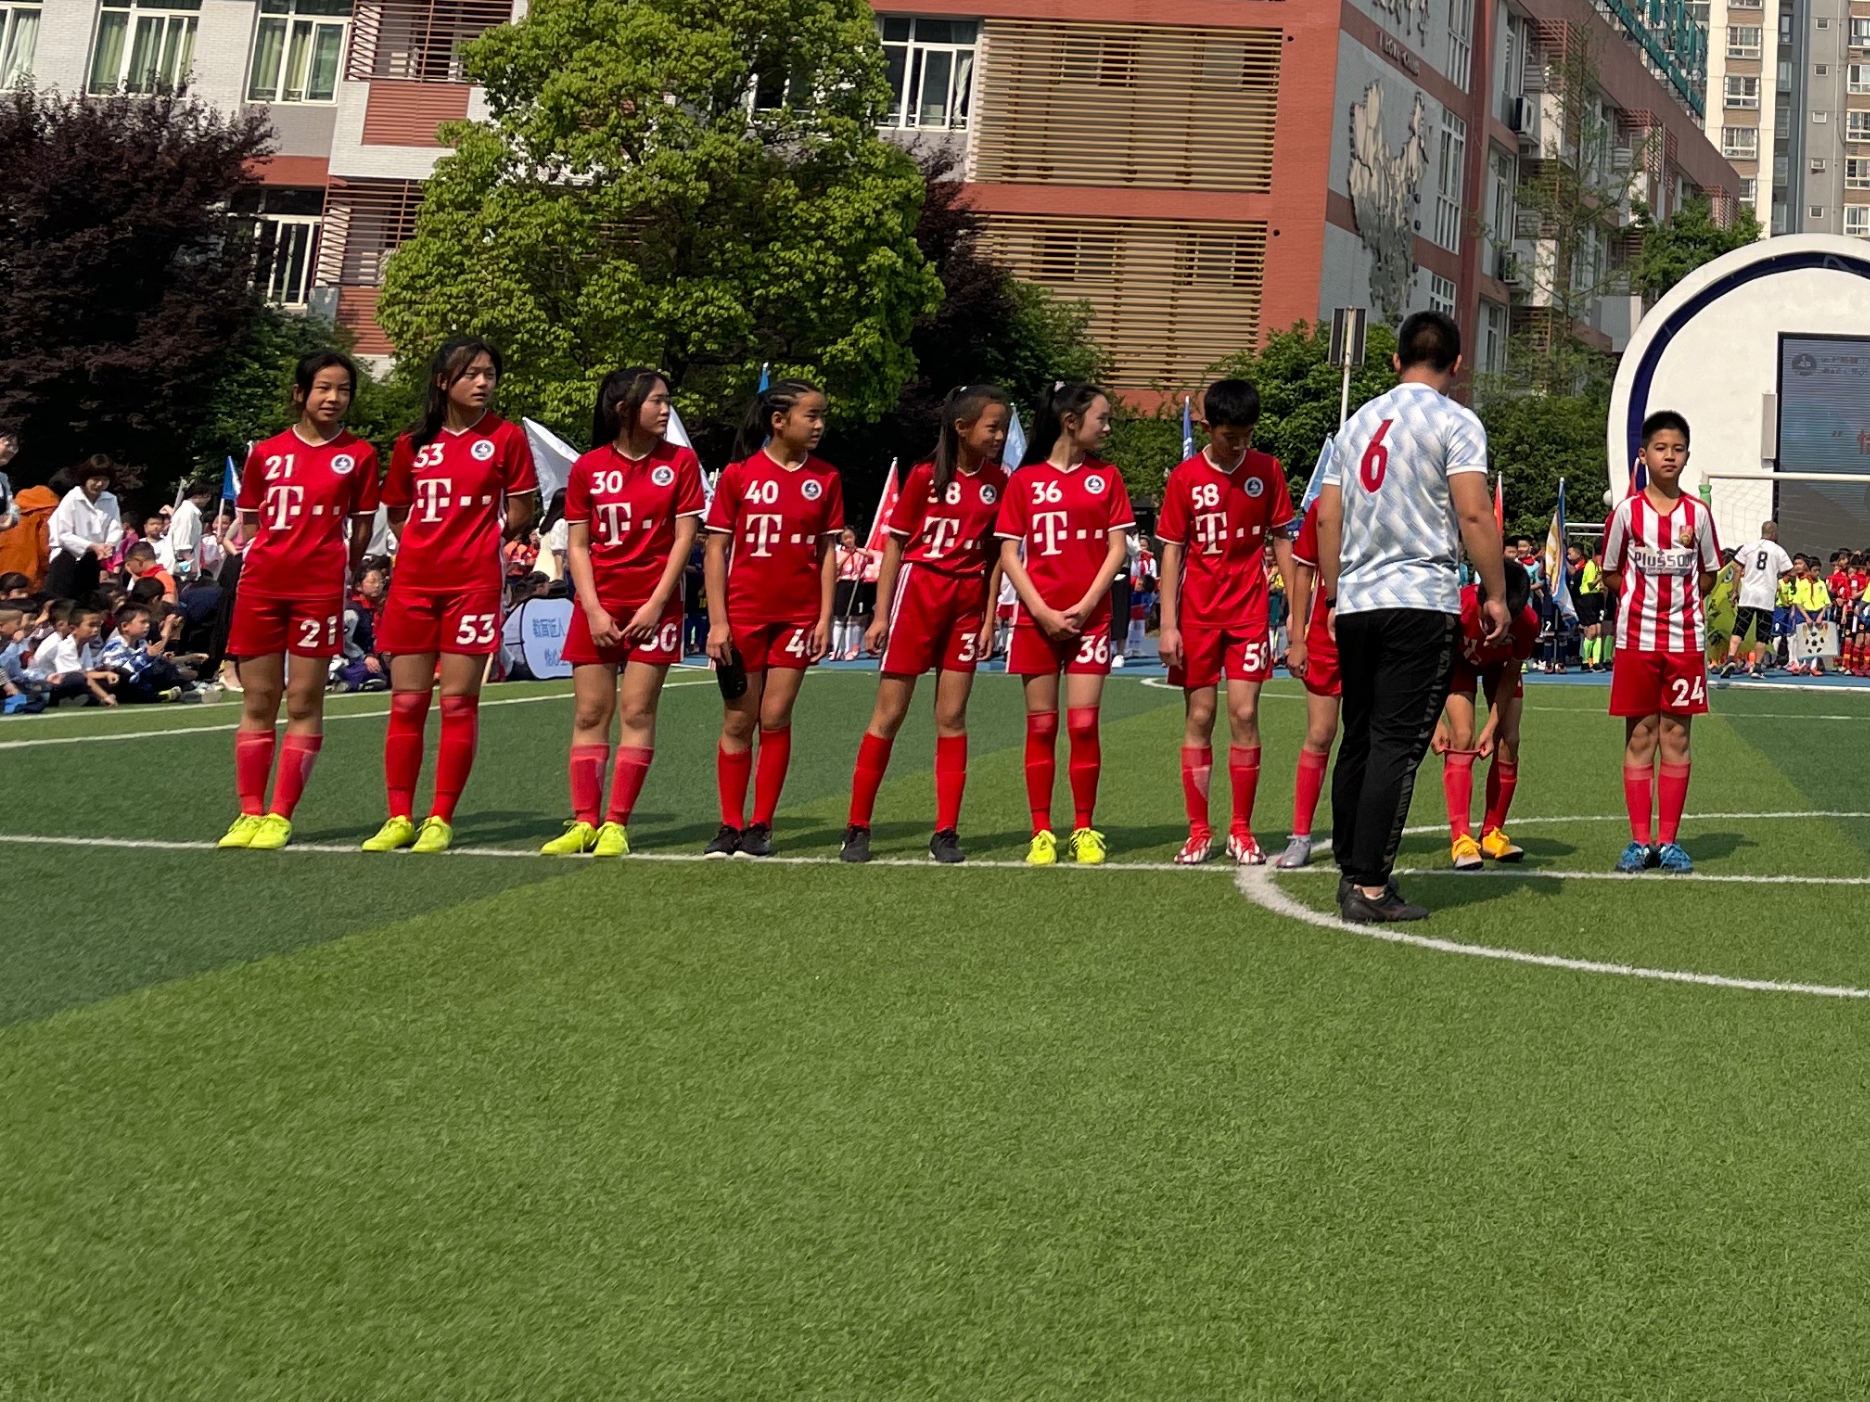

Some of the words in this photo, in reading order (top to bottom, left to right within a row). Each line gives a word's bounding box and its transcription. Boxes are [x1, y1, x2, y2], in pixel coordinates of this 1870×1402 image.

[264, 453, 295, 481] 21
[413, 442, 445, 468] 53
[1360, 418, 1394, 493] 6
[590, 470, 623, 495] 30
[744, 479, 778, 504] 40
[1031, 481, 1063, 504] 36
[1192, 483, 1220, 510] 58
[1756, 550, 1768, 571] 8
[298, 615, 337, 649] 21
[456, 613, 495, 645] 53
[1076, 634, 1109, 664] 36
[1243, 642, 1269, 673] 58
[1671, 676, 1704, 708] 24
